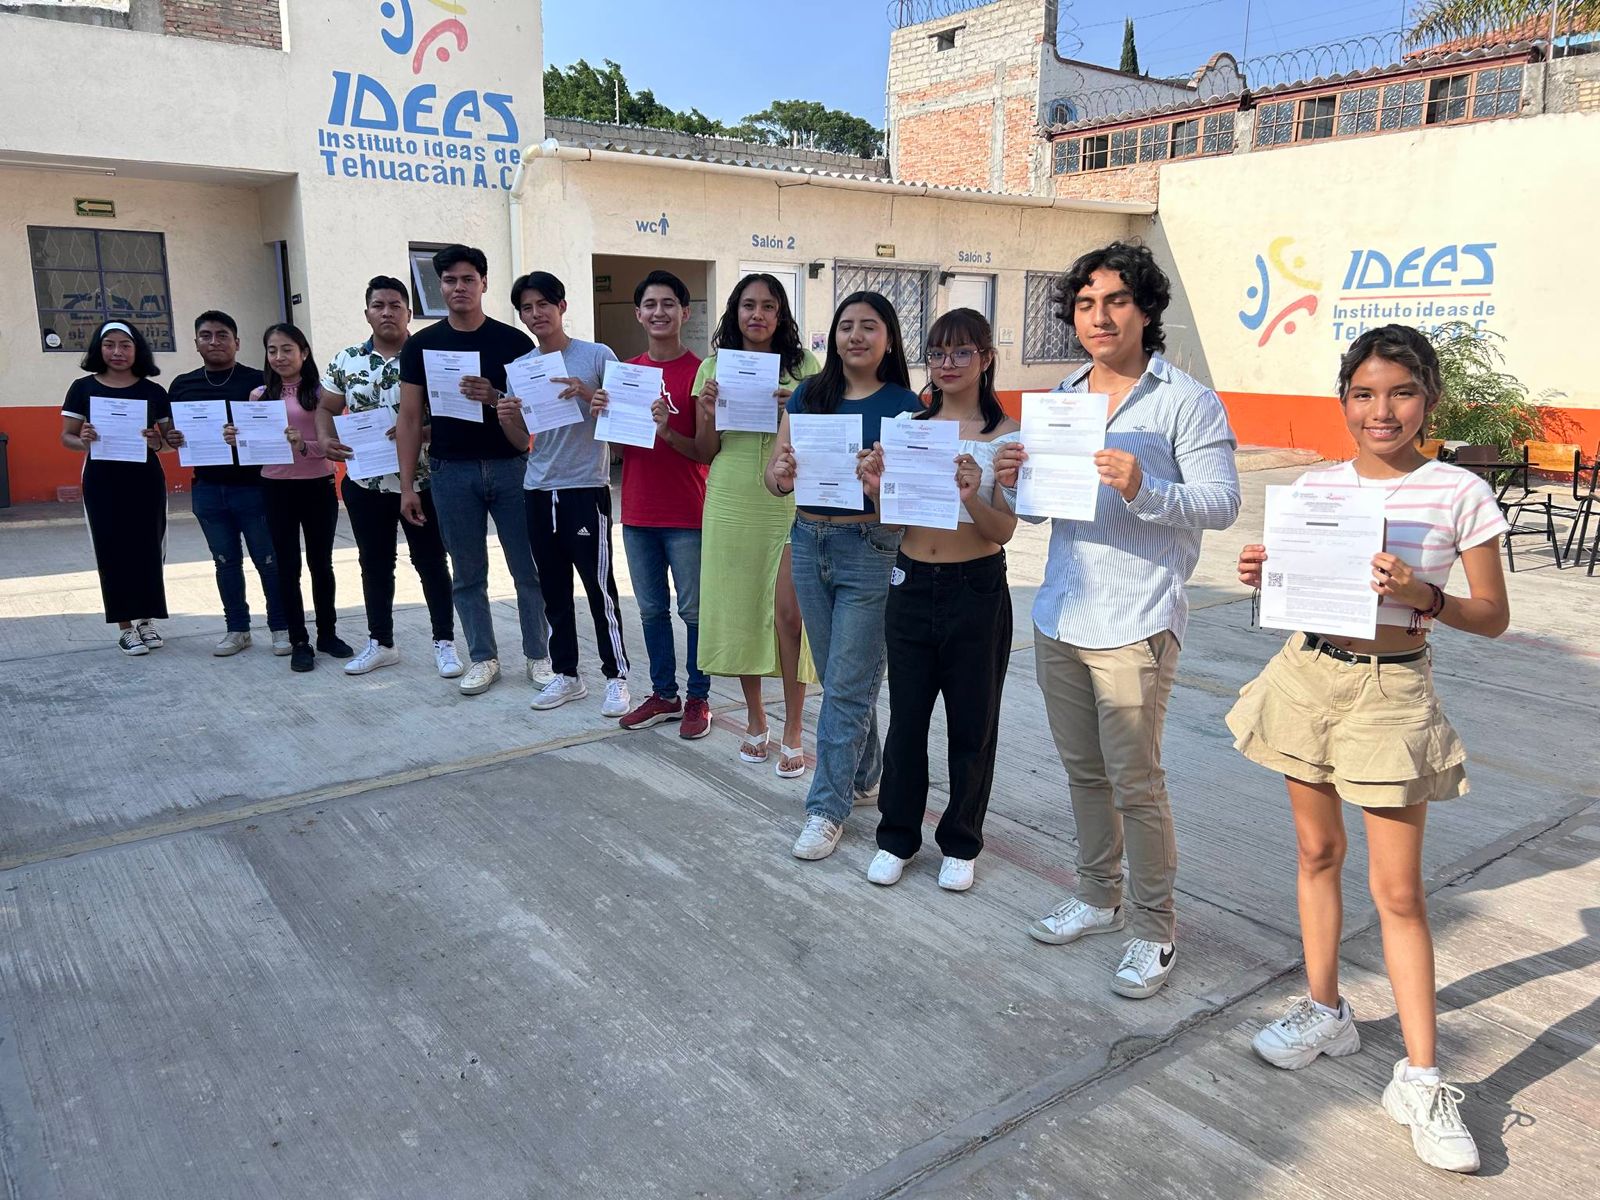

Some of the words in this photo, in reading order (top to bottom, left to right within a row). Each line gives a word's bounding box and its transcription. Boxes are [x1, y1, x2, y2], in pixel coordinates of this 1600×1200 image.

[327, 70, 520, 144] IDEAS
[318, 128, 418, 155] Instituto
[423, 139, 486, 162] ideas
[494, 147, 521, 165] de
[319, 149, 466, 187] Tehuacán
[751, 233, 784, 249] Salón
[786, 236, 795, 250] 2
[958, 250, 982, 263] Salón
[985, 251, 992, 263] 3
[1341, 242, 1497, 290] IDEAS
[1333, 303, 1412, 319] Instituto
[1415, 301, 1469, 317] ideas
[1473, 300, 1496, 316] de
[1332, 320, 1443, 341] Tehán
